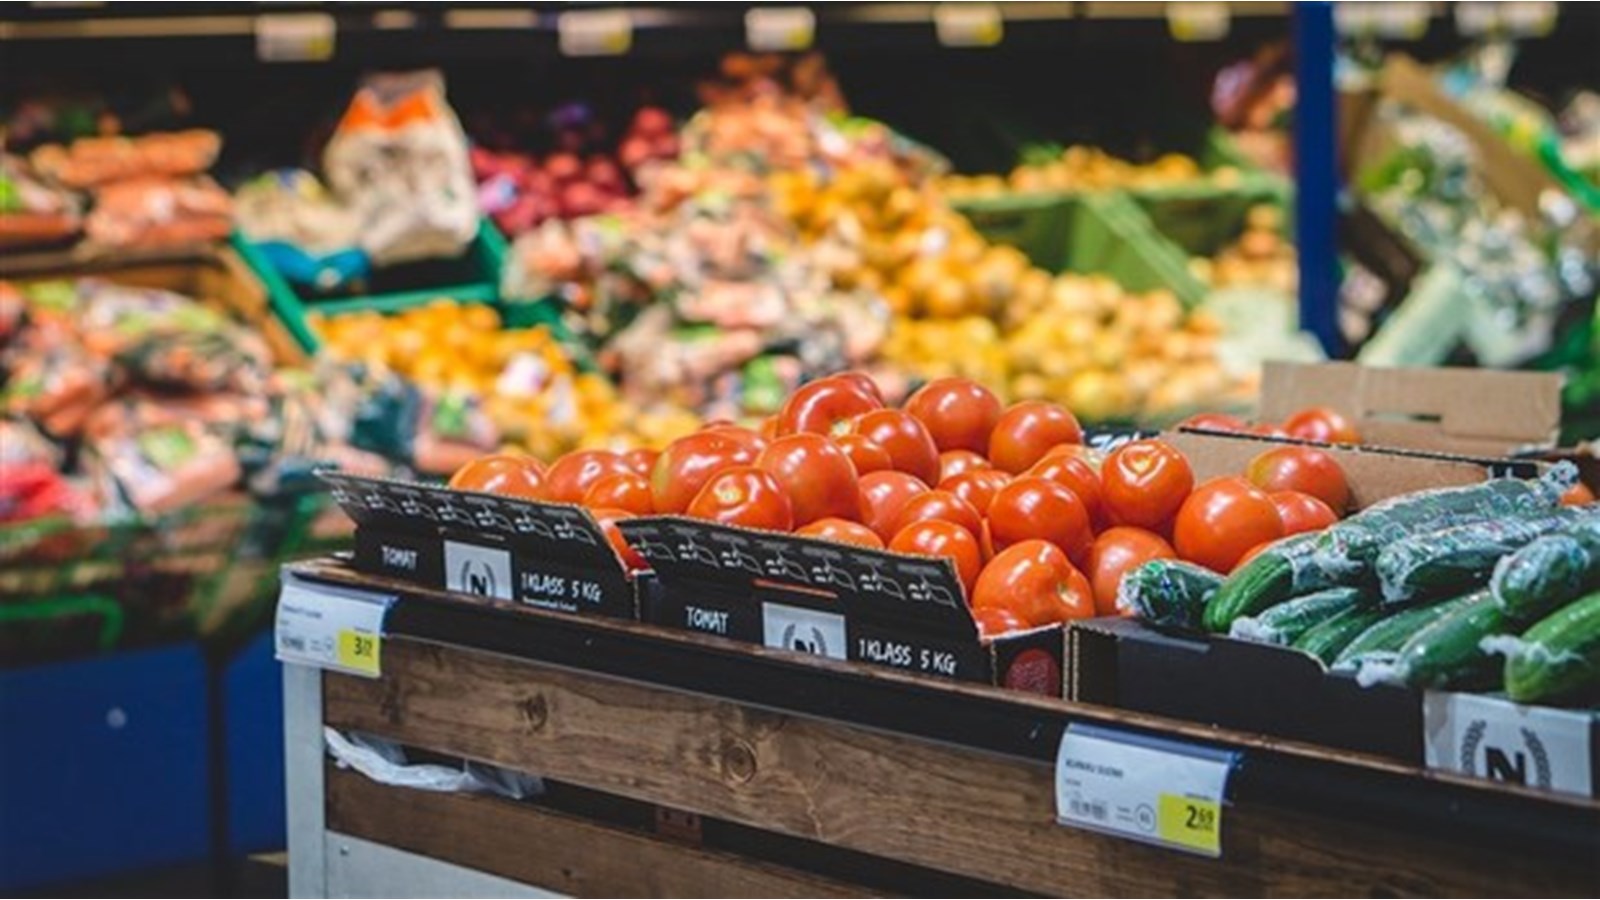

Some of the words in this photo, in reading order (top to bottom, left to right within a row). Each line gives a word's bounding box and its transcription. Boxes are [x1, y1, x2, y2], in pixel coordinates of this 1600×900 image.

[381, 545, 417, 571] TOMAT
[528, 573, 566, 596] KLASS
[572, 580, 580, 599] 5
[582, 581, 603, 603] KG
[684, 605, 729, 635] TOMAT
[867, 640, 913, 666] KLASS
[920, 650, 930, 670] 5
[933, 651, 957, 675] KG
[1485, 746, 1526, 787] N
